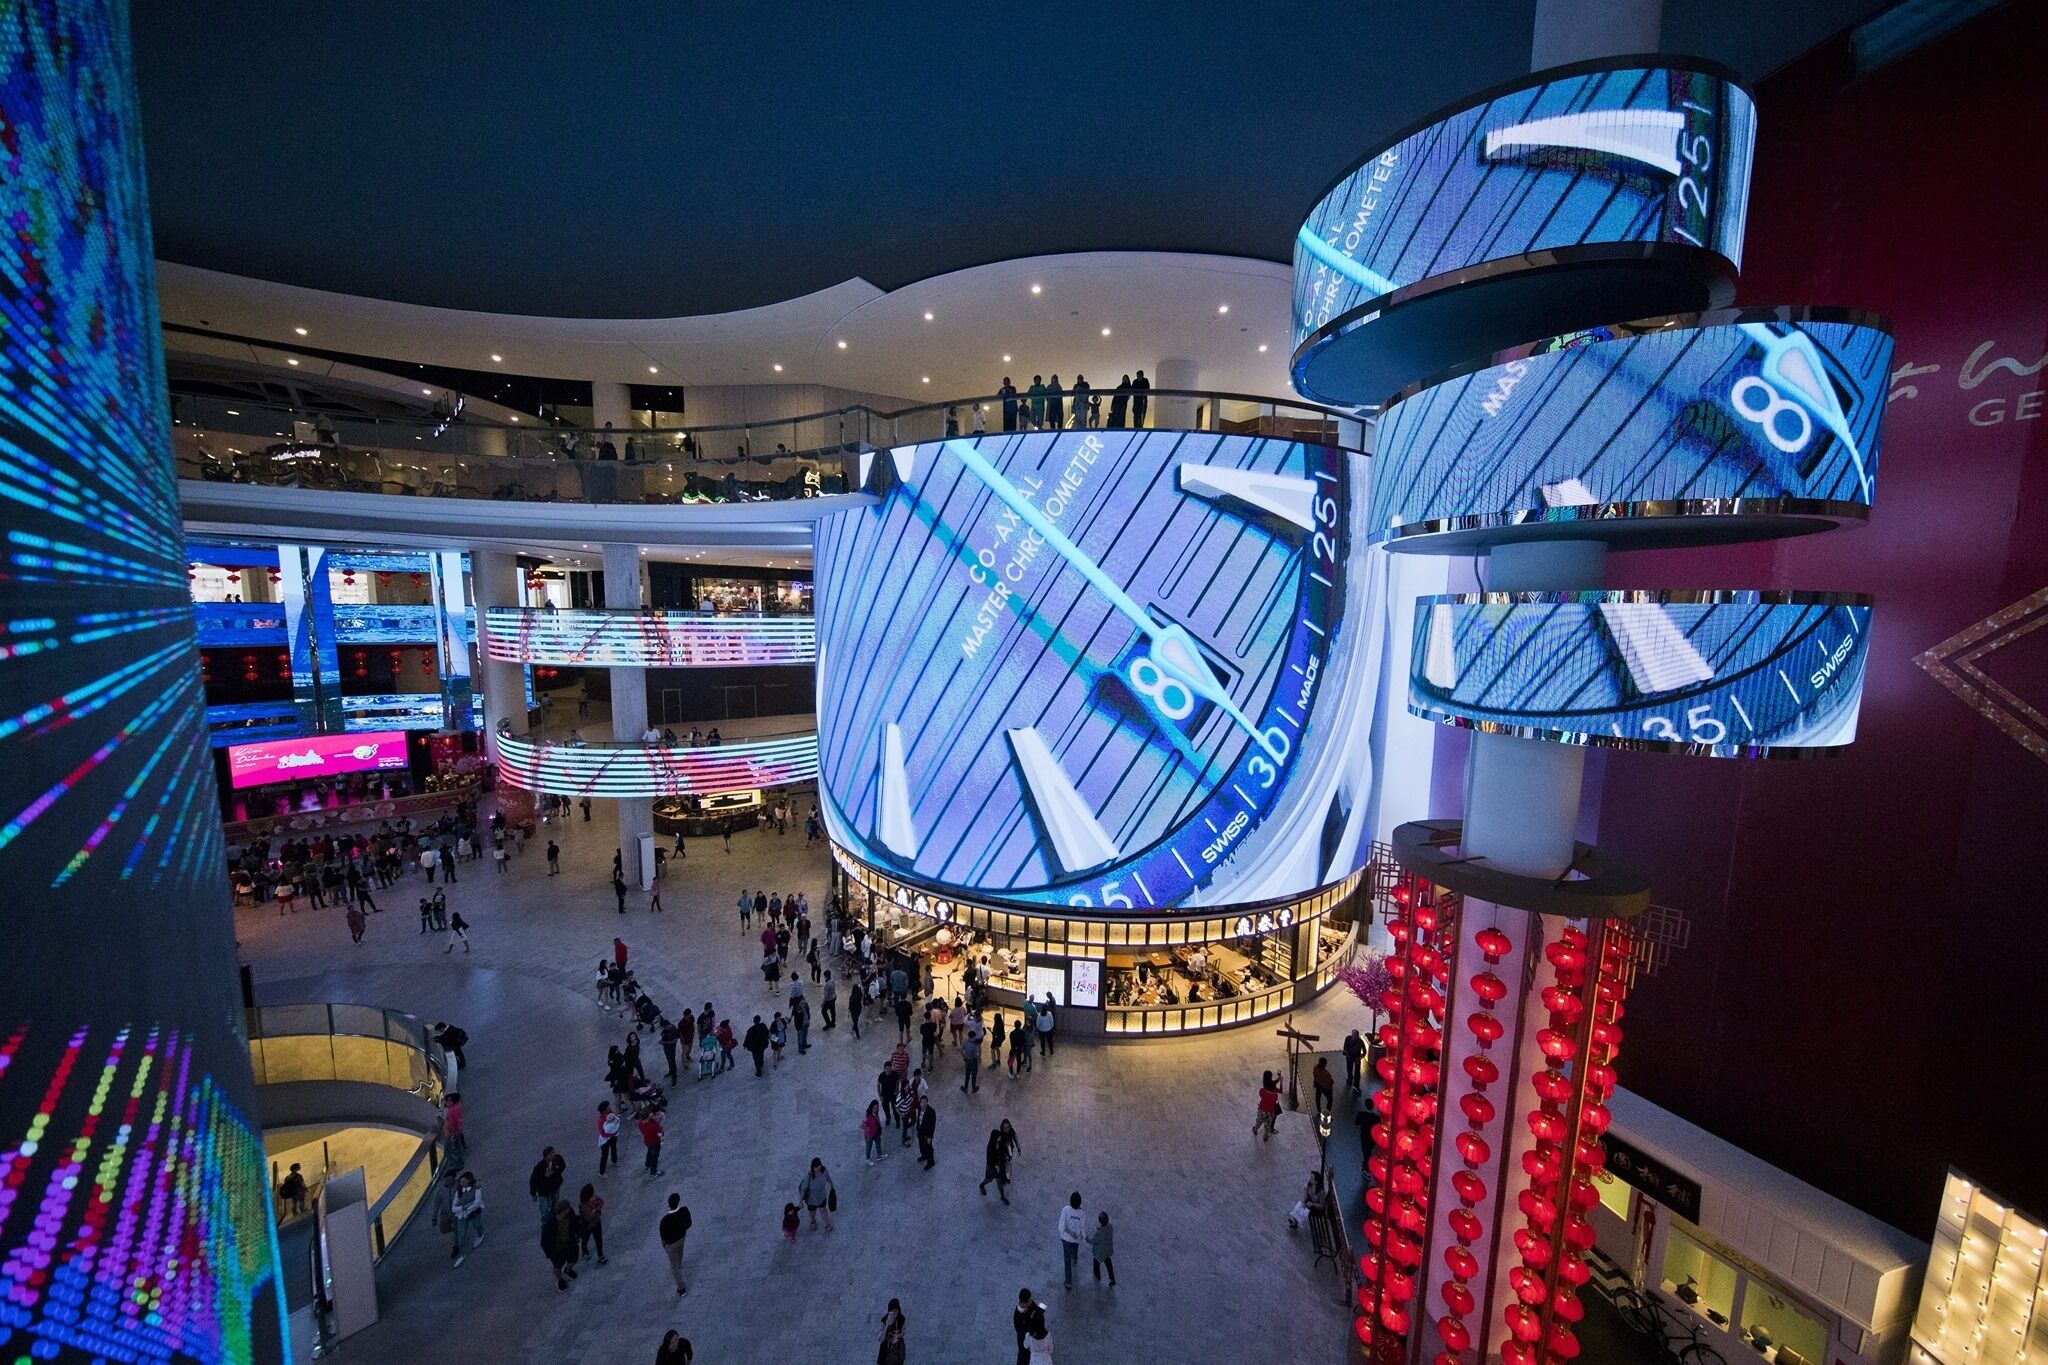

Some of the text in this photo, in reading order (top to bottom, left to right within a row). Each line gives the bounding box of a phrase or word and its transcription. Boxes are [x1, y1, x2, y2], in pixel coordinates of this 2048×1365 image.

[1677, 132, 1713, 219] 25
[1301, 221, 1344, 342] CO-AXAL
[1482, 358, 1532, 416] MAS
[970, 475, 1043, 584] CO-AXAL
[1312, 496, 1337, 563] 25
[960, 582, 1013, 660] MASTER
[1130, 657, 1193, 720] 8
[1297, 654, 1320, 711] MADE
[1810, 634, 1854, 689] SWISS
[1202, 810, 1249, 864] SWISS
